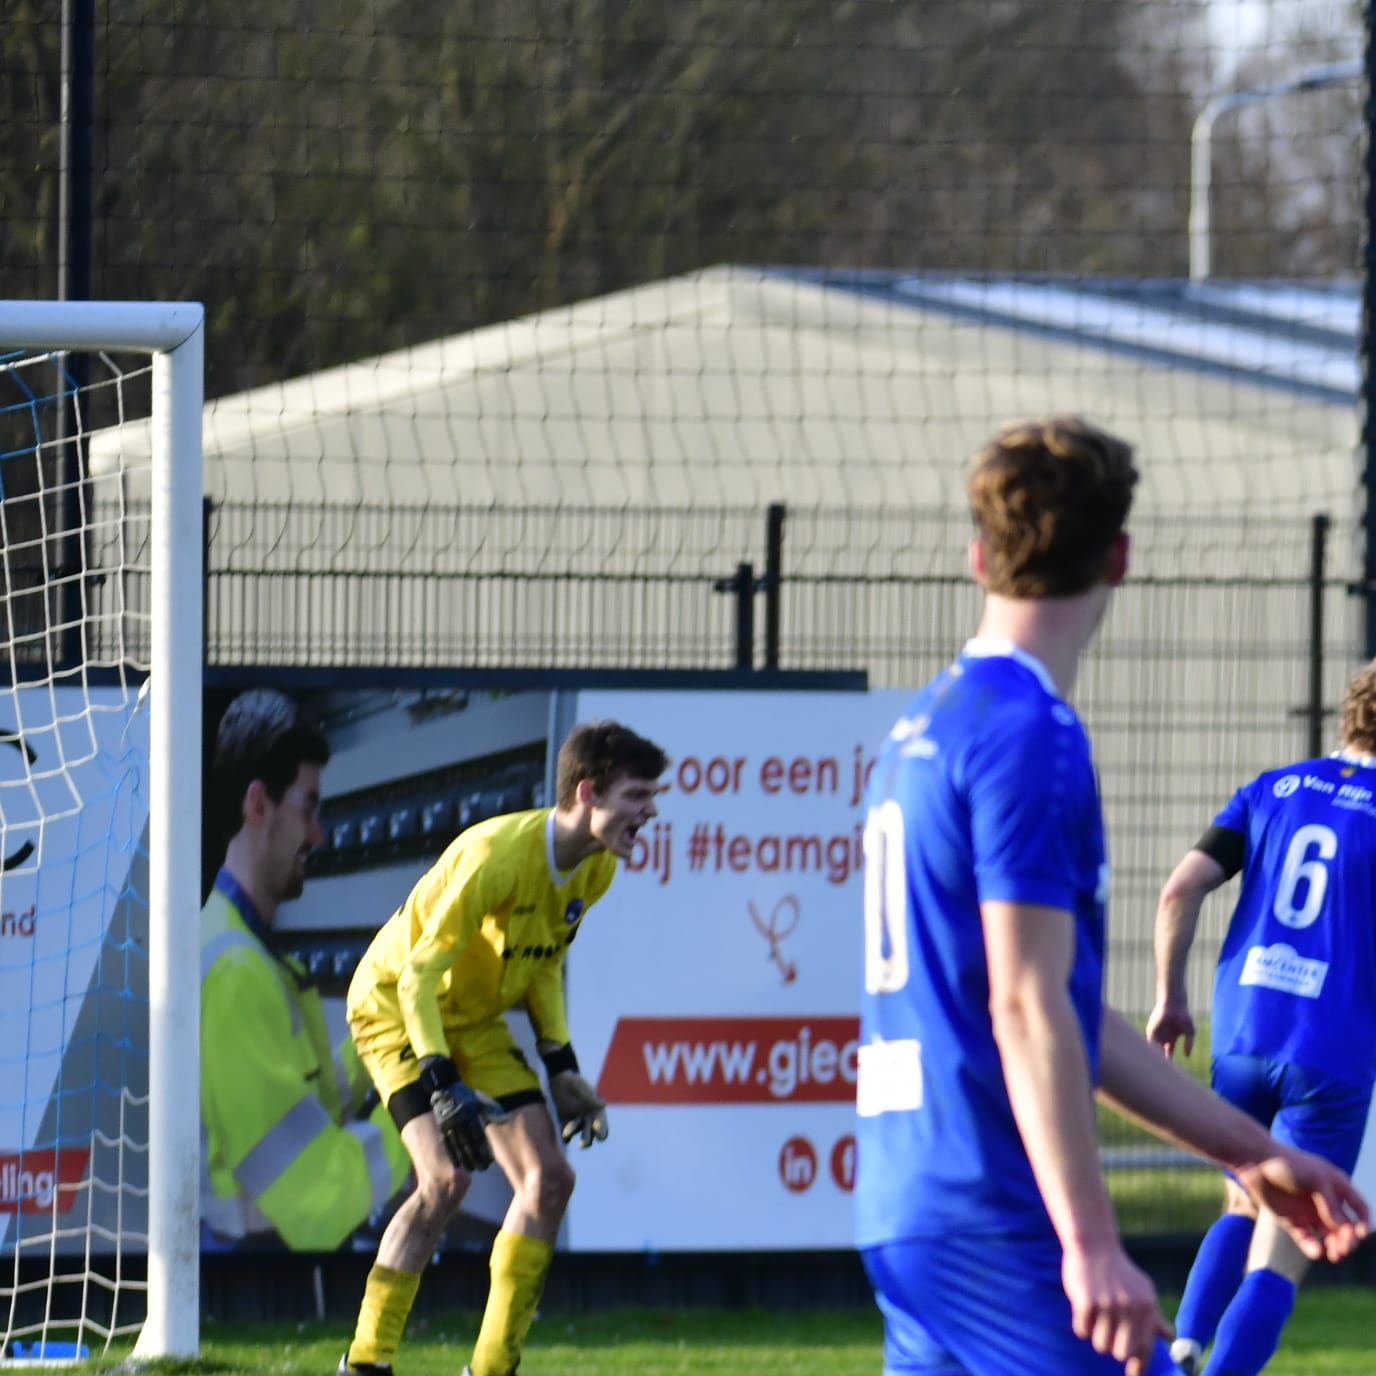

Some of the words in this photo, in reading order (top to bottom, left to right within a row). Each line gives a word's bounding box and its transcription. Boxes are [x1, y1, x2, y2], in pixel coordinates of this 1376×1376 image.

[760, 755, 839, 795] een
[1302, 774, 1335, 795] Van
[1337, 783, 1374, 803] Rijn
[1273, 823, 1338, 930] 6
